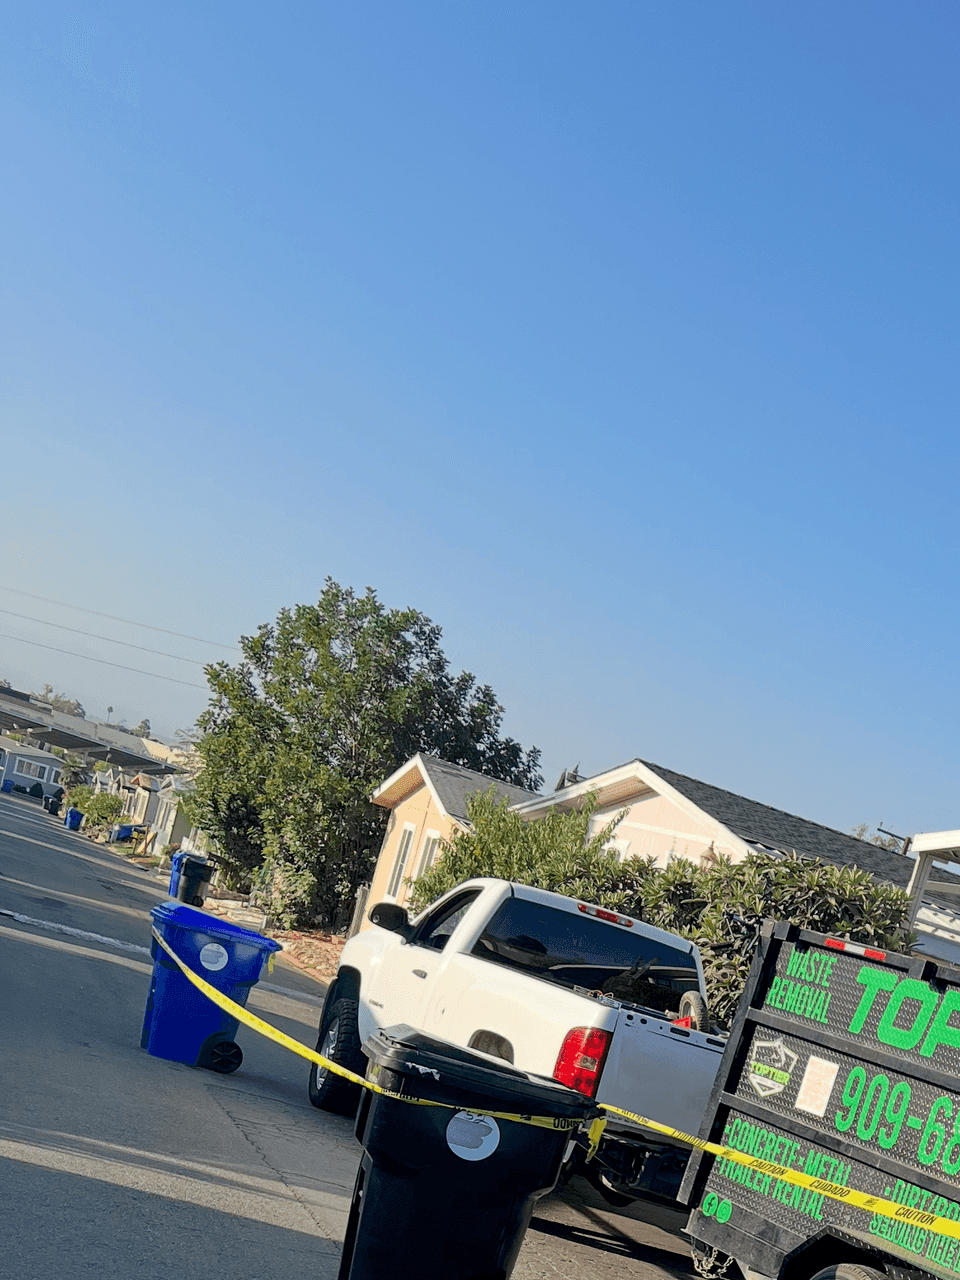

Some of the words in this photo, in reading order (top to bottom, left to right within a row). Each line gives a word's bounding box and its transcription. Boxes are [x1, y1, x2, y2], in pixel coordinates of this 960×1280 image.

[786, 945, 838, 987] WASTE
[766, 976, 832, 1024] REMOVAL
[750, 1159, 789, 1177] CAUTION
[809, 1179, 851, 1198] CUIDADO
[894, 1206, 938, 1226] CAUTION
